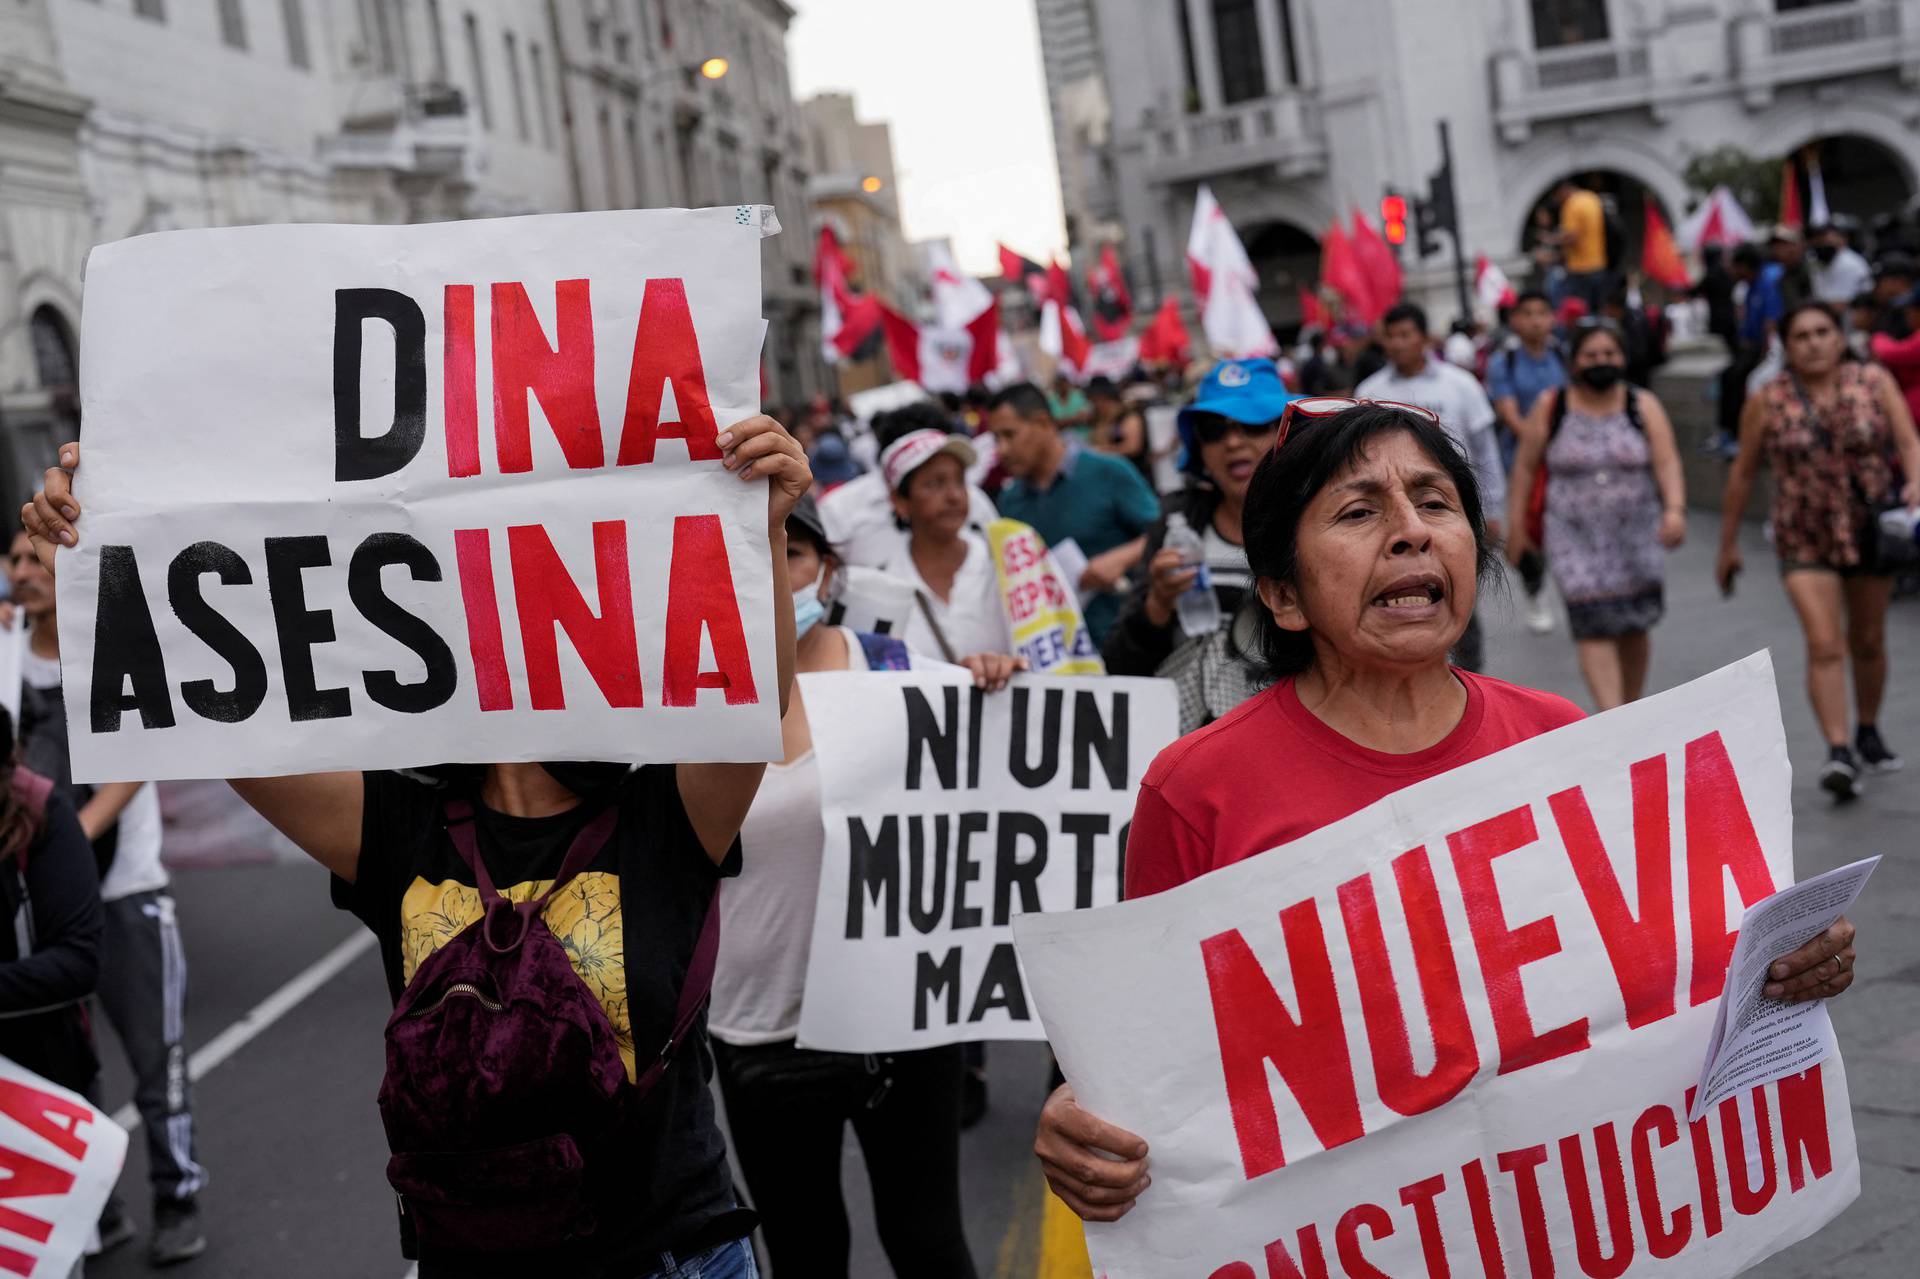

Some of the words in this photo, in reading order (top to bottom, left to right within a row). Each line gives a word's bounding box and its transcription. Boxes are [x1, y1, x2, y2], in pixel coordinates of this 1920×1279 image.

[334, 278, 723, 482] DINA
[90, 514, 759, 733] ASESINA
[902, 685, 985, 791] NI
[1009, 687, 1130, 791] UN
[845, 812, 1133, 940] MUERT
[1200, 729, 1777, 1181] NUEVA
[1207, 1062, 1833, 1279] STITUCION
